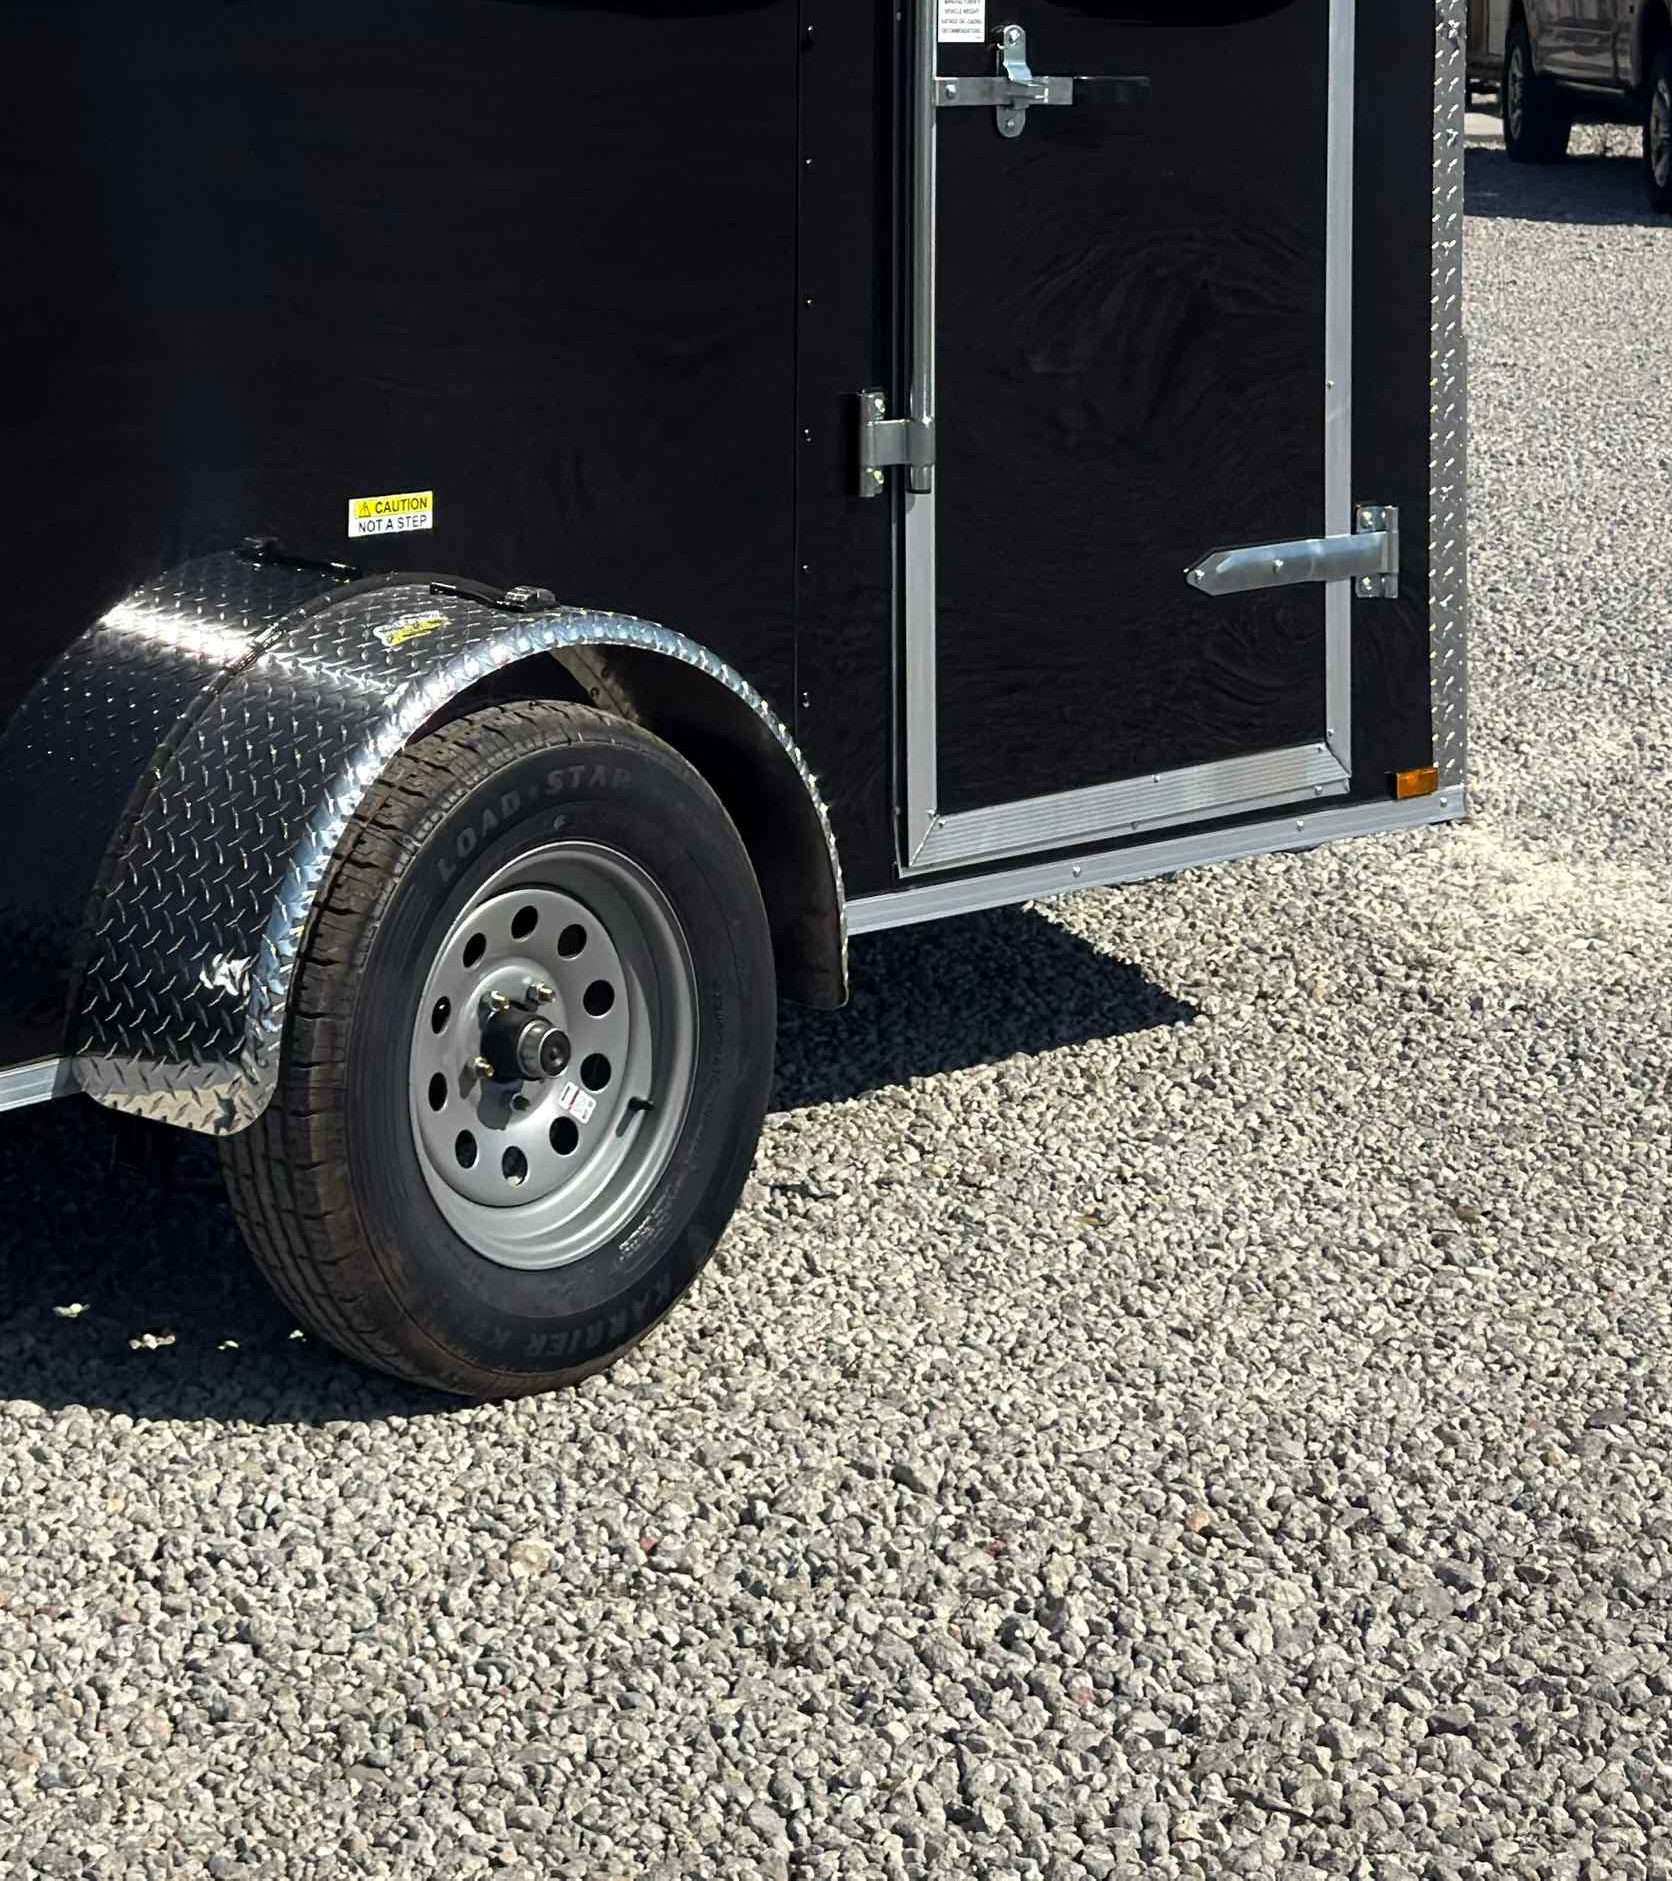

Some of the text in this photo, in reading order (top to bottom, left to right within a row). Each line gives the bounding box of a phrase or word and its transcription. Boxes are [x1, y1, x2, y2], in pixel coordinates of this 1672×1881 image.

[375, 497, 428, 514] CAUTION
[359, 514, 427, 532] NOT A STEP
[438, 790, 522, 886] LOAD
